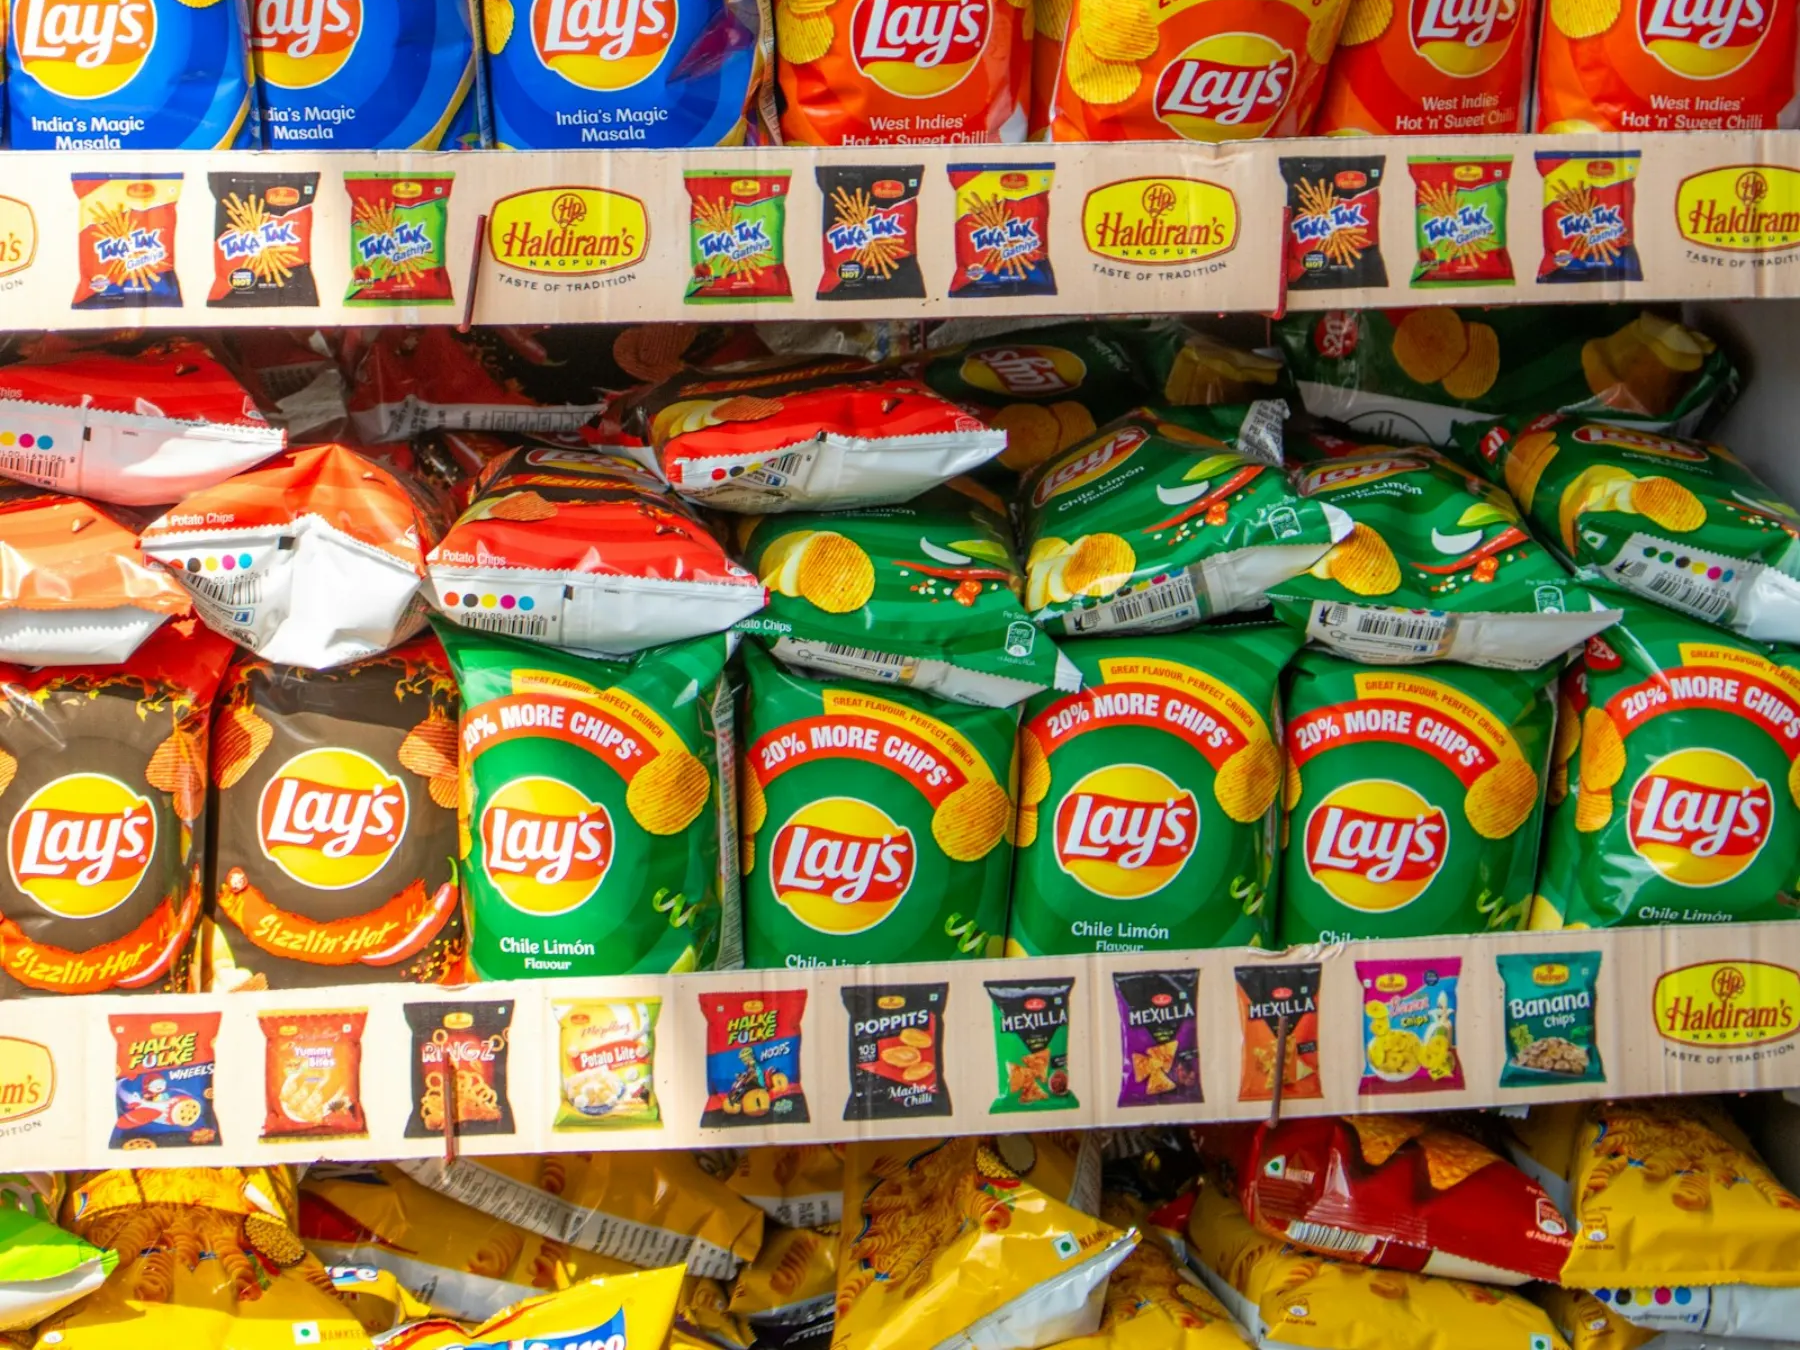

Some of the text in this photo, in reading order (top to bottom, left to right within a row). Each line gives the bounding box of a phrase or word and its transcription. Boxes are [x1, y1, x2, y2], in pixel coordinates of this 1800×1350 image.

[1161, 58, 1289, 126] Lay's
[1650, 94, 1692, 111] West
[304, 105, 355, 124] Magic
[556, 107, 669, 126] India's Magic
[869, 116, 911, 131] West
[1395, 112, 1486, 131] Hot Sweet
[1621, 112, 1763, 130] Hot Sweet Chilli
[31, 115, 145, 135] India's Magic
[273, 123, 334, 141] Masala
[581, 127, 645, 142] Masala
[55, 135, 121, 150] Masala
[1096, 212, 1225, 247] Haldiram's
[502, 221, 635, 259] Haldiram's
[1122, 248, 1198, 256] NAGPUR
[1686, 250, 1724, 266] TASTE
[529, 259, 607, 267] NAGPUR
[1092, 262, 1227, 281] TASTE OF TRADITION
[498, 273, 637, 293] TASTE OF TRADITION
[171, 512, 235, 526] Potato Chips
[442, 549, 476, 565] Potato
[1110, 665, 1140, 675] GREAT
[1187, 676, 1225, 701] PERFECT
[1225, 697, 1255, 729] CRUNCH
[1670, 676, 1740, 702] MORE
[499, 703, 564, 730] MORE
[1046, 693, 1159, 739] 20% MORE
[761, 725, 880, 771] 20% MORE
[267, 779, 400, 859] Lay's
[1636, 777, 1767, 856] Lay's
[1063, 794, 1191, 869] Lay's
[18, 807, 148, 887] Lay's
[489, 809, 605, 885] Lay's
[1313, 807, 1441, 883] Lay's
[779, 826, 908, 904] Lay's
[1638, 905, 1732, 922] Chile Limón
[340, 921, 399, 950] Hot
[1071, 920, 1169, 940] Chile Limón
[500, 937, 595, 956] Chile Limón
[101, 941, 153, 978] Hot
[524, 958, 572, 970] Flavour
[1129, 1002, 1194, 1026] MEXILLA
[1249, 999, 1315, 1019] MEXILLA
[1509, 991, 1590, 1019] Banana
[1666, 996, 1793, 1031] Haldiram's
[727, 1009, 780, 1033] HALKE
[855, 1009, 928, 1036] POPPITS
[1001, 1009, 1069, 1034] MEXILLA
[1543, 1013, 1576, 1029] Chips
[129, 1031, 197, 1056] HALKE
[1692, 1031, 1767, 1040] NAGPUR
[580, 1050, 614, 1069] Potato
[760, 1041, 791, 1062] HOOPS
[1664, 1042, 1795, 1065] TASTE OF TRADITION
[168, 1064, 215, 1081] WHEELS
[888, 1083, 927, 1099] Macho
[904, 1093, 932, 1107] Chilli
